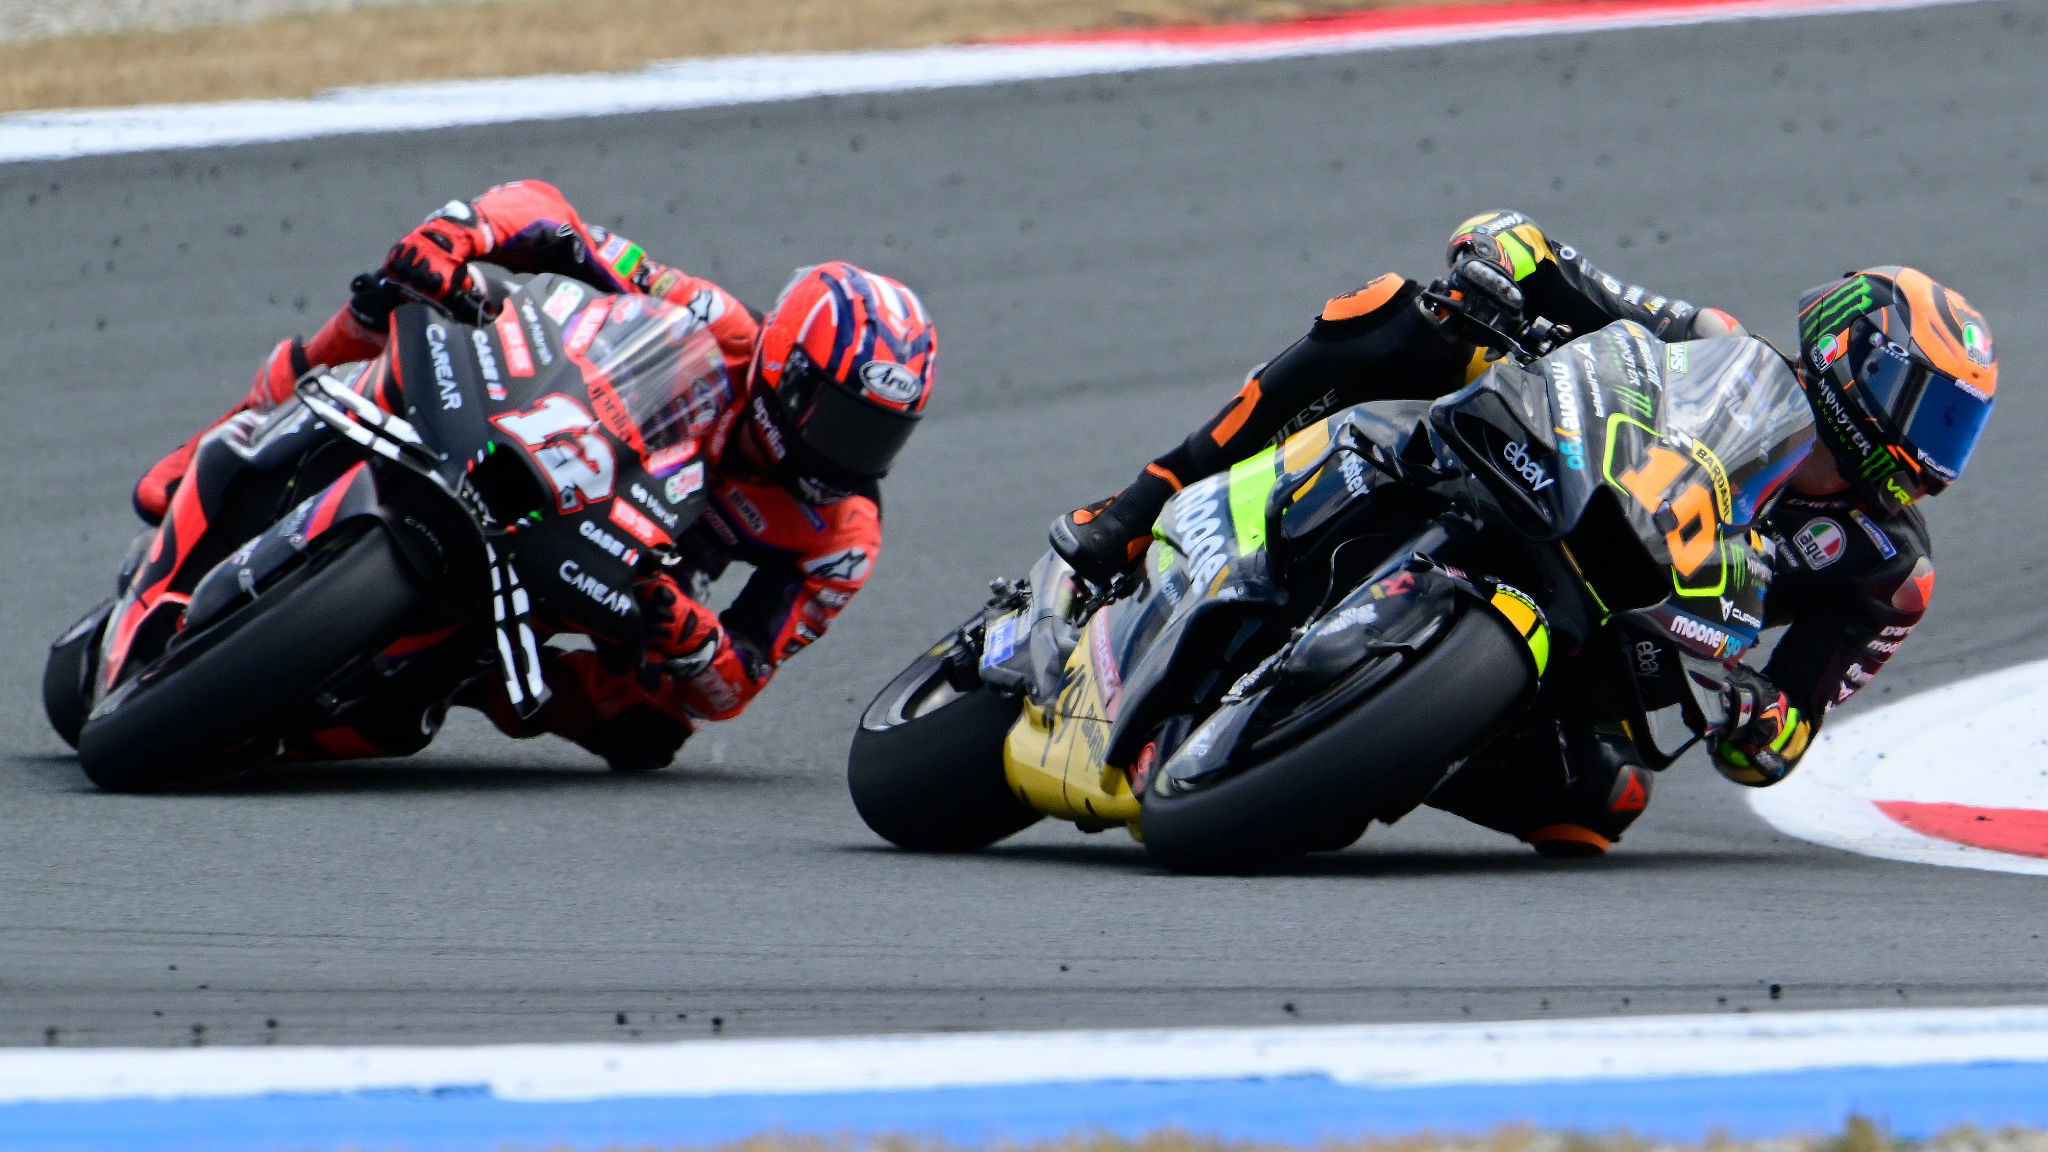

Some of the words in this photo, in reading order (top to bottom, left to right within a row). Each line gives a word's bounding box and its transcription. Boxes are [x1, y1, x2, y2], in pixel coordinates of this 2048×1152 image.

[426, 323, 463, 410] CAREAR
[1503, 441, 1555, 491] ebay
[559, 559, 633, 616] CAREAR
